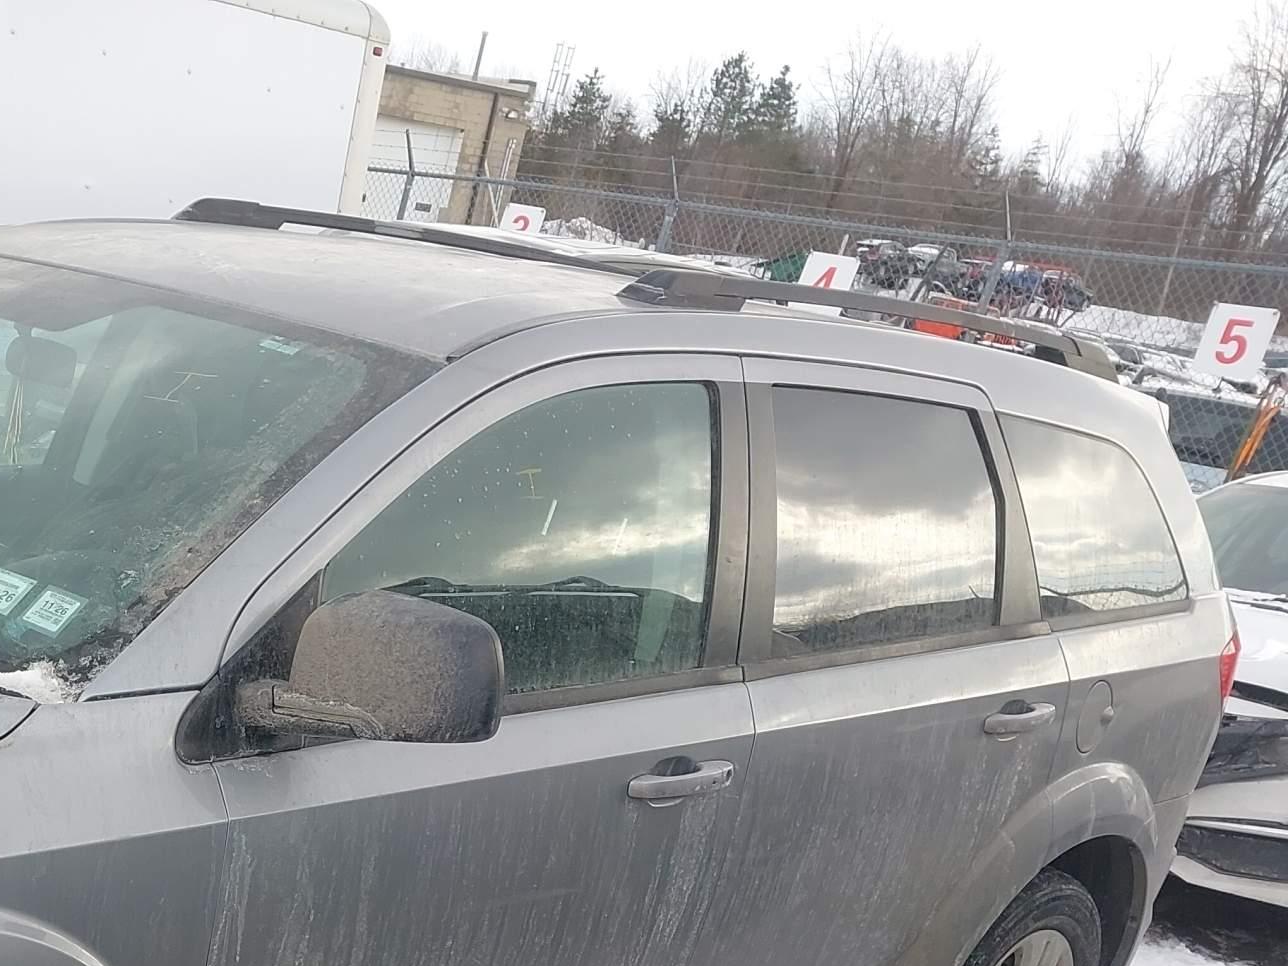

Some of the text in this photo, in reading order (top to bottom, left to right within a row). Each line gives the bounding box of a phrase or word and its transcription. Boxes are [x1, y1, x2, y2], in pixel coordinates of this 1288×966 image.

[1215, 318, 1255, 364] 5
[42, 600, 56, 611] 11
[54, 605, 70, 616] 26
